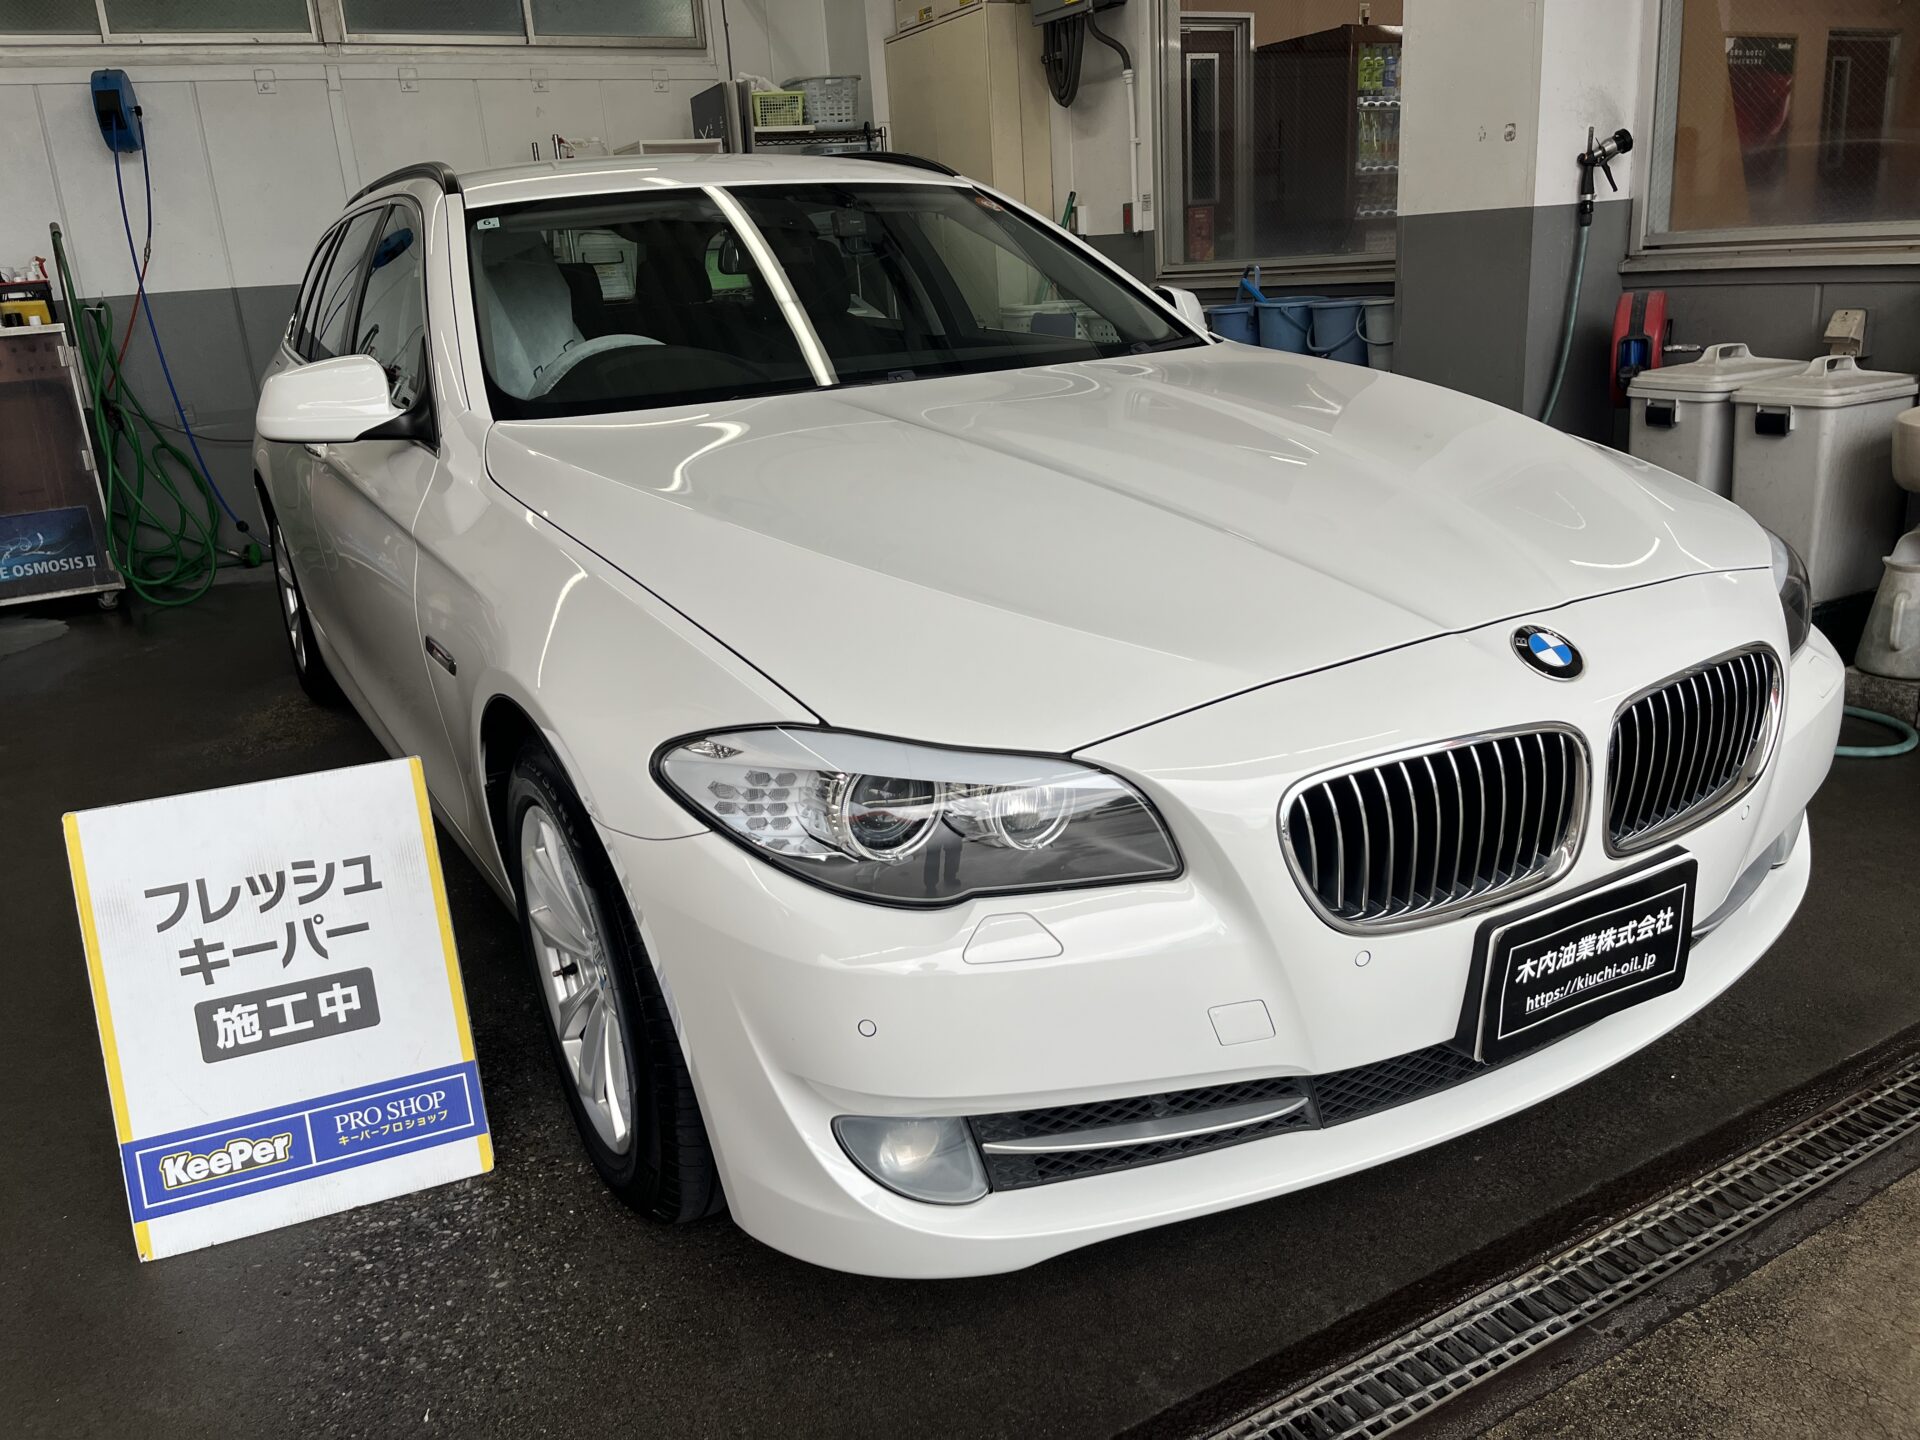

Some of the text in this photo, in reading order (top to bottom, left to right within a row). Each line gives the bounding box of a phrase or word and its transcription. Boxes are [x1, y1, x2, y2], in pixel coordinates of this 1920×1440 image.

[12, 556, 84, 578] OSMOSIS
[144, 854, 383, 934] フレッシュ
[178, 913, 370, 986] キーパー
[1515, 906, 1675, 985] 木内油業株式会社
[1525, 952, 1657, 1014] https://kiuchi-oil.jp
[212, 982, 362, 1050] 施工中
[333, 1090, 446, 1134] PRO SHOP
[161, 1133, 291, 1189] KeePer
